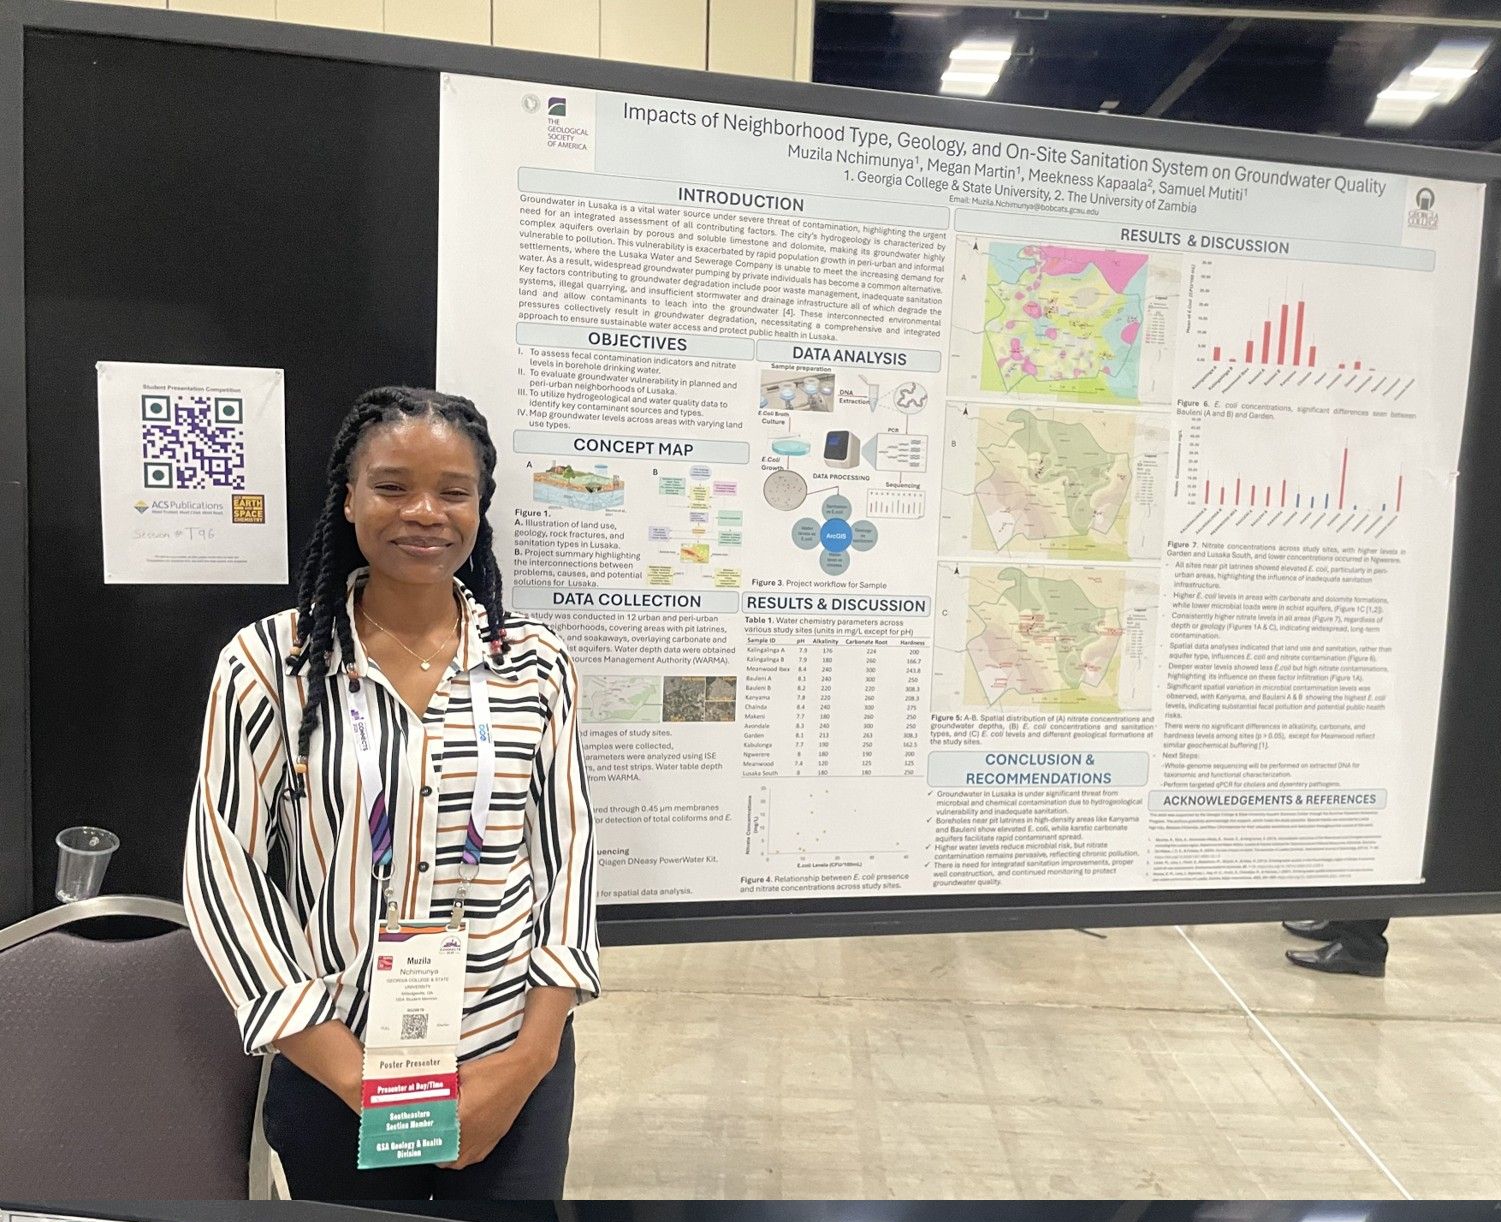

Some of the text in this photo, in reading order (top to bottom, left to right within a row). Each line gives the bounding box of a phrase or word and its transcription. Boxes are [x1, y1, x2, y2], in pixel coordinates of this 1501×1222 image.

[624, 103, 1386, 198] Impacts of Neighborhood Type, Geology, and On-Site Sanitation System on Groundwater Quality
[678, 187, 804, 211] INTRODUCTION
[1120, 227, 1289, 254] RESULTS & DISCUSSION
[588, 332, 687, 350] OBJECTIVES
[530, 348, 736, 369] To assess fecal contamination indicators and nitrate
[793, 347, 907, 366] DATA ANALYSIS
[574, 438, 694, 457] CONCEPT MAP
[234, 510, 263, 518] SPACE
[553, 592, 701, 608] DATA COLLECTION
[747, 597, 926, 612] RESULTS & DISCUSSION
[985, 754, 1095, 766] CONCLUSION &
[966, 773, 1112, 784] RECOMMENDATIONS
[1163, 794, 1377, 806] ACKNOWLEDGEMENTS & REFERENCES
[406, 956, 431, 966] Muzila
[380, 1058, 441, 1070] Poster Presenter
